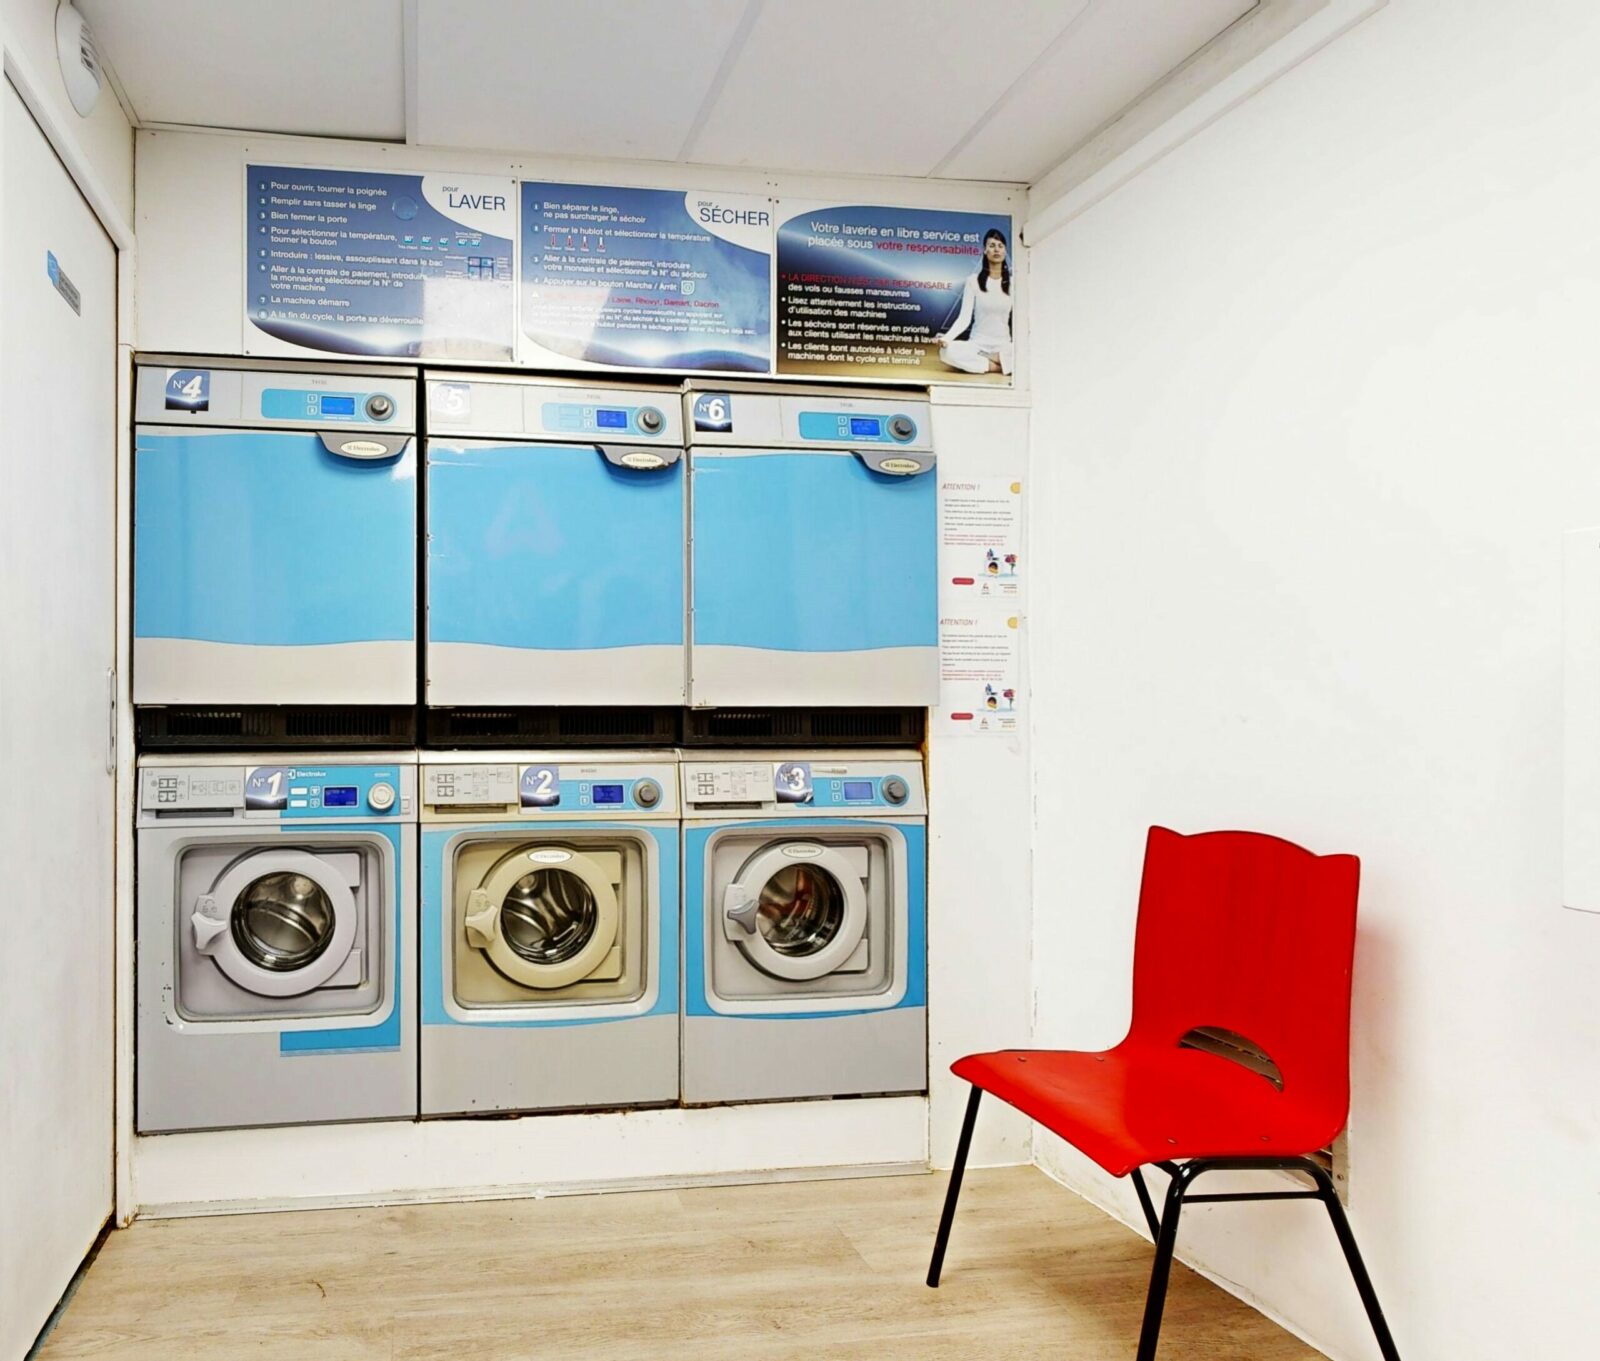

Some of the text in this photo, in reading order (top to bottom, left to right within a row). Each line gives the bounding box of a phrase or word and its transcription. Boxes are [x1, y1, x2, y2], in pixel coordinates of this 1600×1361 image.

[271, 182, 387, 197] Pour ouvrir, tourner la poignée
[271, 196, 300, 206] Remplir
[324, 200, 346, 208] tasser
[358, 202, 376, 211] linge
[450, 193, 505, 211] LAVER
[544, 202, 560, 210] Bien
[562, 203, 590, 213] séparer
[600, 206, 620, 214] linge,
[271, 212, 288, 220] Bien
[290, 213, 315, 221] fermer
[327, 215, 348, 224] porte
[570, 214, 609, 223] surcharger
[620, 215, 646, 224] séchoir
[700, 205, 769, 226] SÉCHER
[271, 226, 289, 234] Pour
[292, 228, 338, 237] sélectionner
[349, 231, 398, 242] température,
[544, 225, 570, 234] Fermer
[580, 227, 603, 236] hublot
[614, 229, 658, 239] sélectionner
[668, 232, 711, 243] température
[811, 222, 979, 243] Votre laverie en libre service est
[271, 236, 299, 244] tourner
[310, 238, 336, 246] bouton
[808, 235, 844, 248] placée
[848, 239, 873, 248] sous
[876, 240, 903, 251] votre
[271, 250, 308, 259] Introduire
[315, 252, 344, 262] lessive,
[346, 255, 398, 264] assouplissant
[577, 256, 606, 265] centrale
[656, 260, 690, 268] introduire
[271, 265, 288, 273] Aller
[306, 268, 337, 276] centrale
[352, 270, 389, 279] paiement,
[564, 265, 594, 273] monnaie
[606, 266, 649, 276] sélectionner
[682, 270, 708, 280] séchoir
[293, 283, 326, 292] machine
[324, 276, 370, 286] sélectionner
[544, 277, 574, 287] Appuyer
[598, 280, 624, 288] bouton
[626, 281, 652, 290] Marche
[788, 272, 952, 290] LA DIRECTION RESPONSABLE
[788, 283, 802, 292] des
[805, 284, 820, 293] vols
[834, 285, 864, 296] fausses
[866, 288, 910, 298] manœuvres
[282, 296, 316, 304] machine
[318, 298, 349, 306] démarre
[788, 296, 920, 311] Lisez attentivement les instructions
[346, 315, 366, 323] porte
[788, 306, 887, 319] d'utilisation des machines
[788, 318, 802, 328] Les
[804, 319, 836, 330] séchoirs
[838, 322, 855, 330] sont
[858, 322, 889, 332] réservés
[904, 323, 930, 334] priorité
[788, 329, 802, 337] aux
[804, 329, 830, 339] clients
[832, 330, 861, 340] utilisant
[863, 332, 874, 341] les
[876, 332, 912, 343] machines
[914, 334, 920, 343] à
[788, 342, 925, 356] Les clients sont autorisés vider les
[788, 351, 920, 364] machines dont le cycle est terminé
[296, 770, 326, 778] Electrolux
